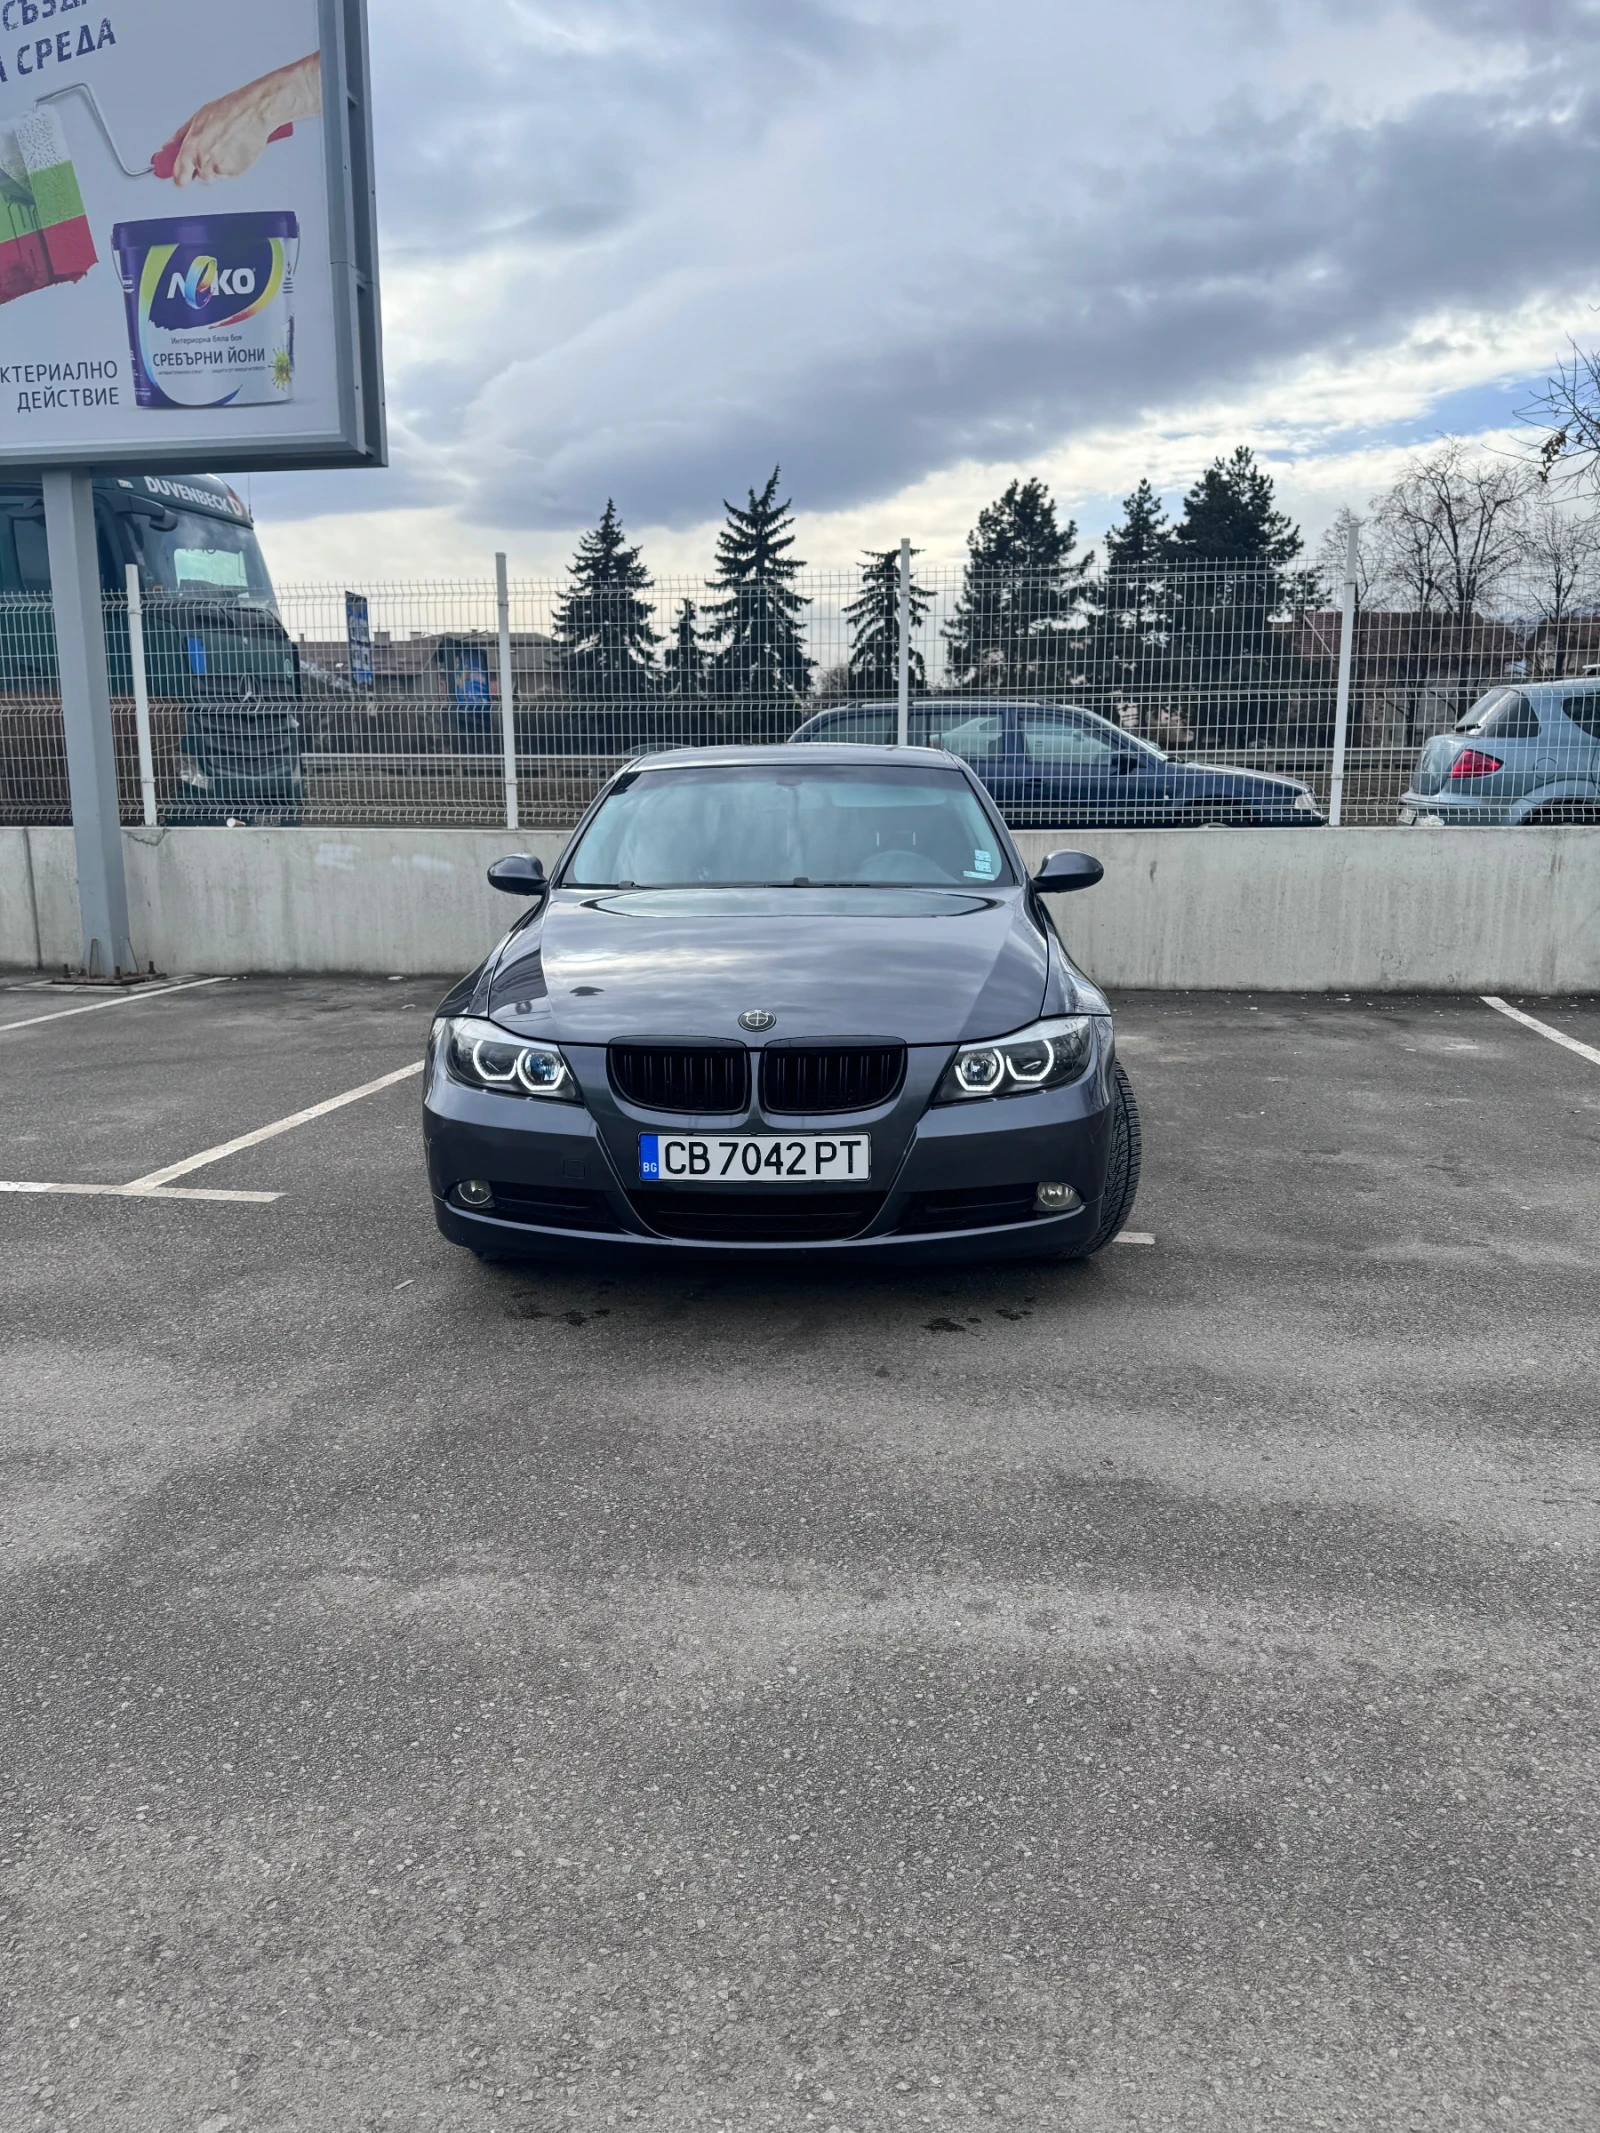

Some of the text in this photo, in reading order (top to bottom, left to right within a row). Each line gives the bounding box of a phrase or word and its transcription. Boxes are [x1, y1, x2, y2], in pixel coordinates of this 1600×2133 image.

[2, 0, 88, 31] СЪЗ
[16, 17, 117, 76] СРЕДА
[230, 333, 243, 342] боя
[152, 346, 266, 367] СРЕБЪРНИ ЙОНИ
[0, 360, 118, 383] КТЕРИАЛНО
[17, 385, 120, 413] ДЕЙСТВИЕ
[143, 475, 232, 514] DUVENBECK
[642, 1162, 658, 1173] BG
[664, 1140, 862, 1176] CB 7042 PT
